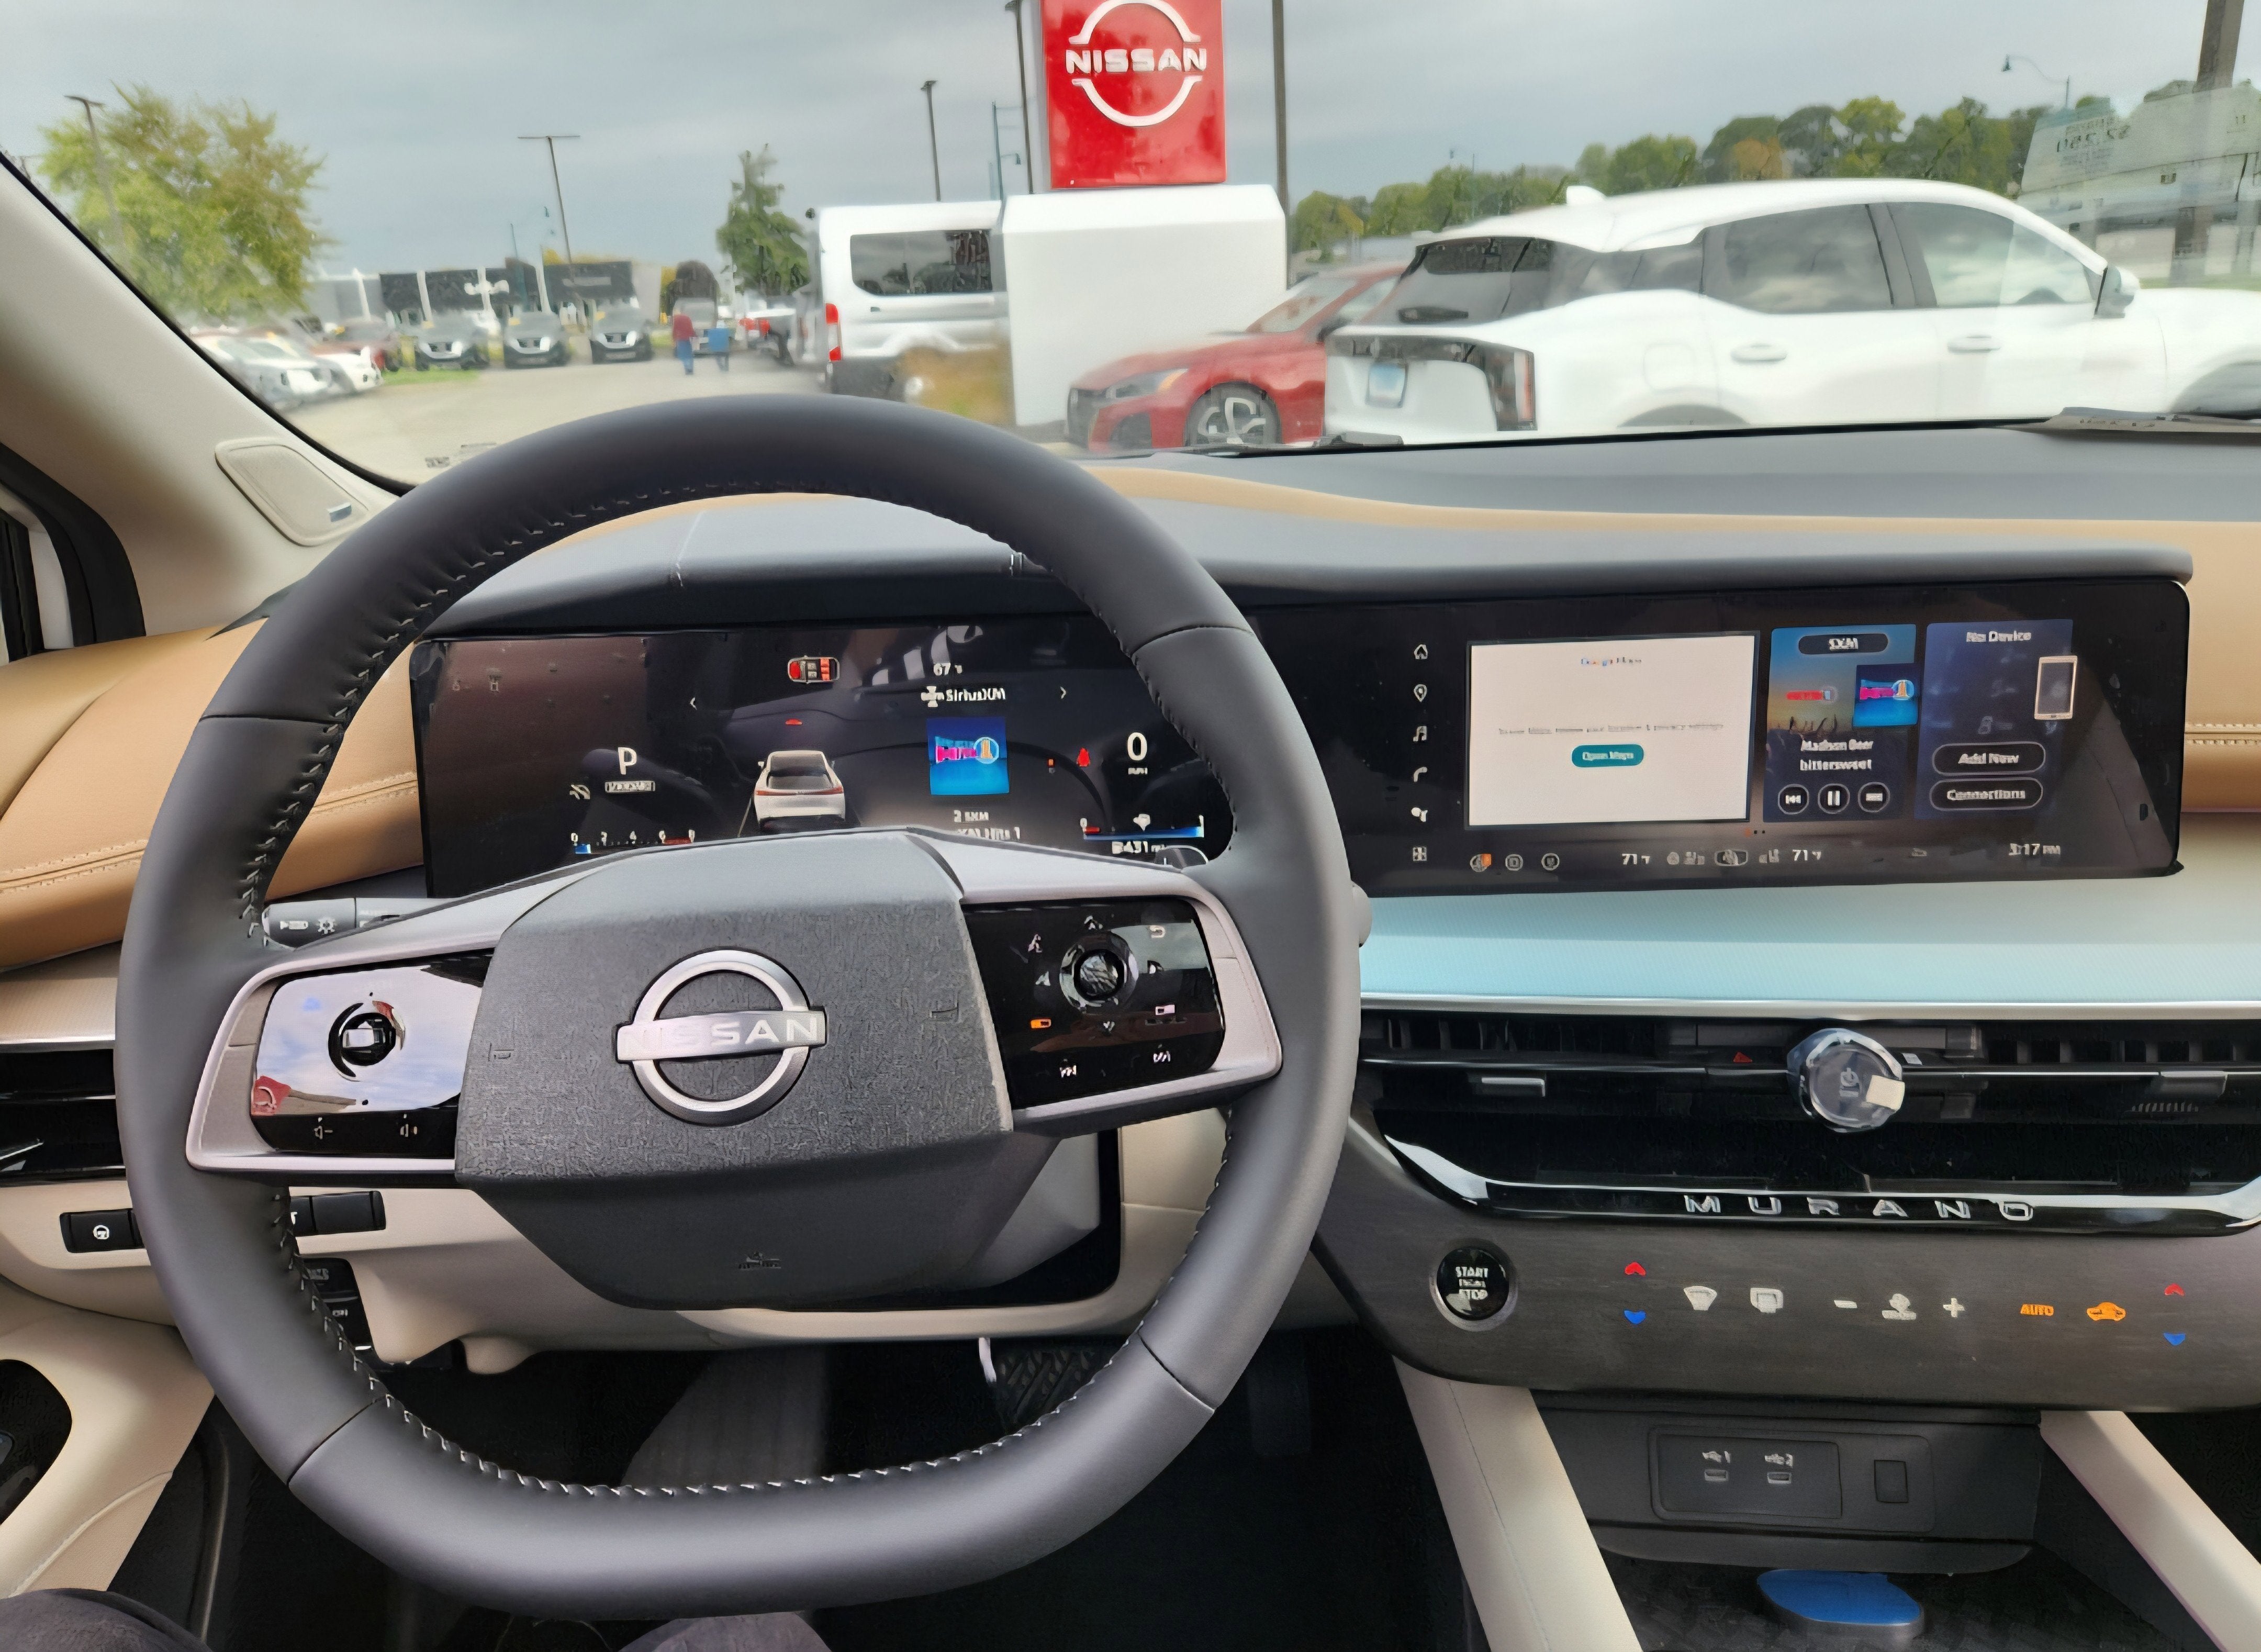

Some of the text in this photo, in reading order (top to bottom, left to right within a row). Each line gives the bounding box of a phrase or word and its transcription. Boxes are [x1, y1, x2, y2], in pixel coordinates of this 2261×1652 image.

[1065, 48, 1207, 74] NISSAN
[1127, 732, 1148, 761] 0
[618, 746, 637, 775] P
[1683, 1195, 2034, 1222] MURANO
[1456, 1266, 1488, 1278] START
[2020, 1303, 2054, 1316] AUTO
